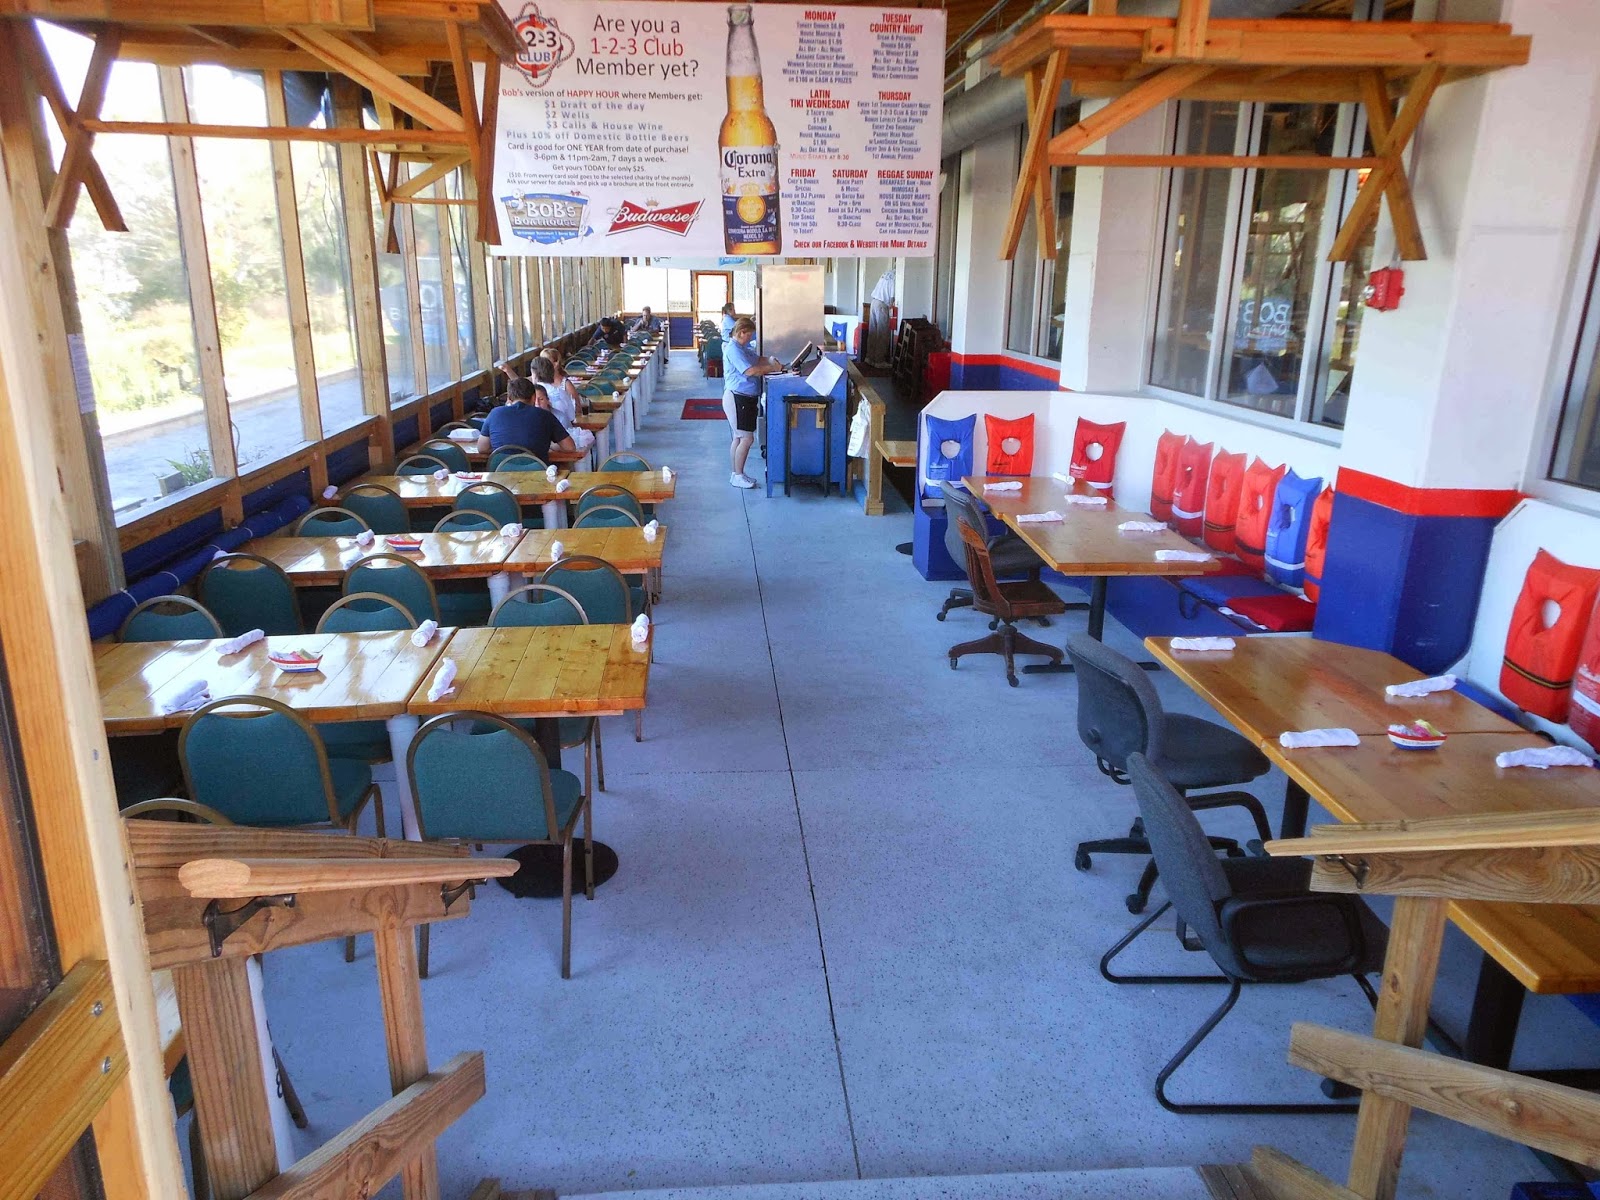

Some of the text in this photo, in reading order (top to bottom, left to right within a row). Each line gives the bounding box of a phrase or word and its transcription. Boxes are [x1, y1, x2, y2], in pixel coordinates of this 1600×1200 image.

[805, 11, 836, 20] MONDAY
[882, 14, 912, 23] TUESDAY
[594, 15, 680, 36] Are you a
[870, 23, 923, 34] COUNTRY NIGHT
[525, 31, 557, 48] 2-3
[591, 38, 684, 56] 1-2-3 Club
[518, 52, 551, 62] CLUB
[576, 58, 699, 80] Member yet?
[687, 93, 702, 101] get:
[810, 89, 830, 98] LATIN
[879, 91, 911, 100] THURSDAY
[545, 101, 556, 109] $1
[627, 102, 645, 111] day
[790, 99, 850, 108] TIKI WEDNESDAY
[545, 110, 557, 119] $2
[546, 121, 558, 129] $3
[574, 132, 621, 140] Domestic
[534, 144, 552, 152] good
[534, 153, 557, 161] 3-6pm
[568, 154, 609, 162] 11pm-2am,
[725, 150, 772, 170] Corona
[738, 167, 766, 178] Extra
[791, 169, 816, 177] FRIDAY
[832, 169, 868, 178] SATURDAY
[878, 170, 933, 179] REGGAE SUNDAY
[614, 206, 699, 223] Budweiser
